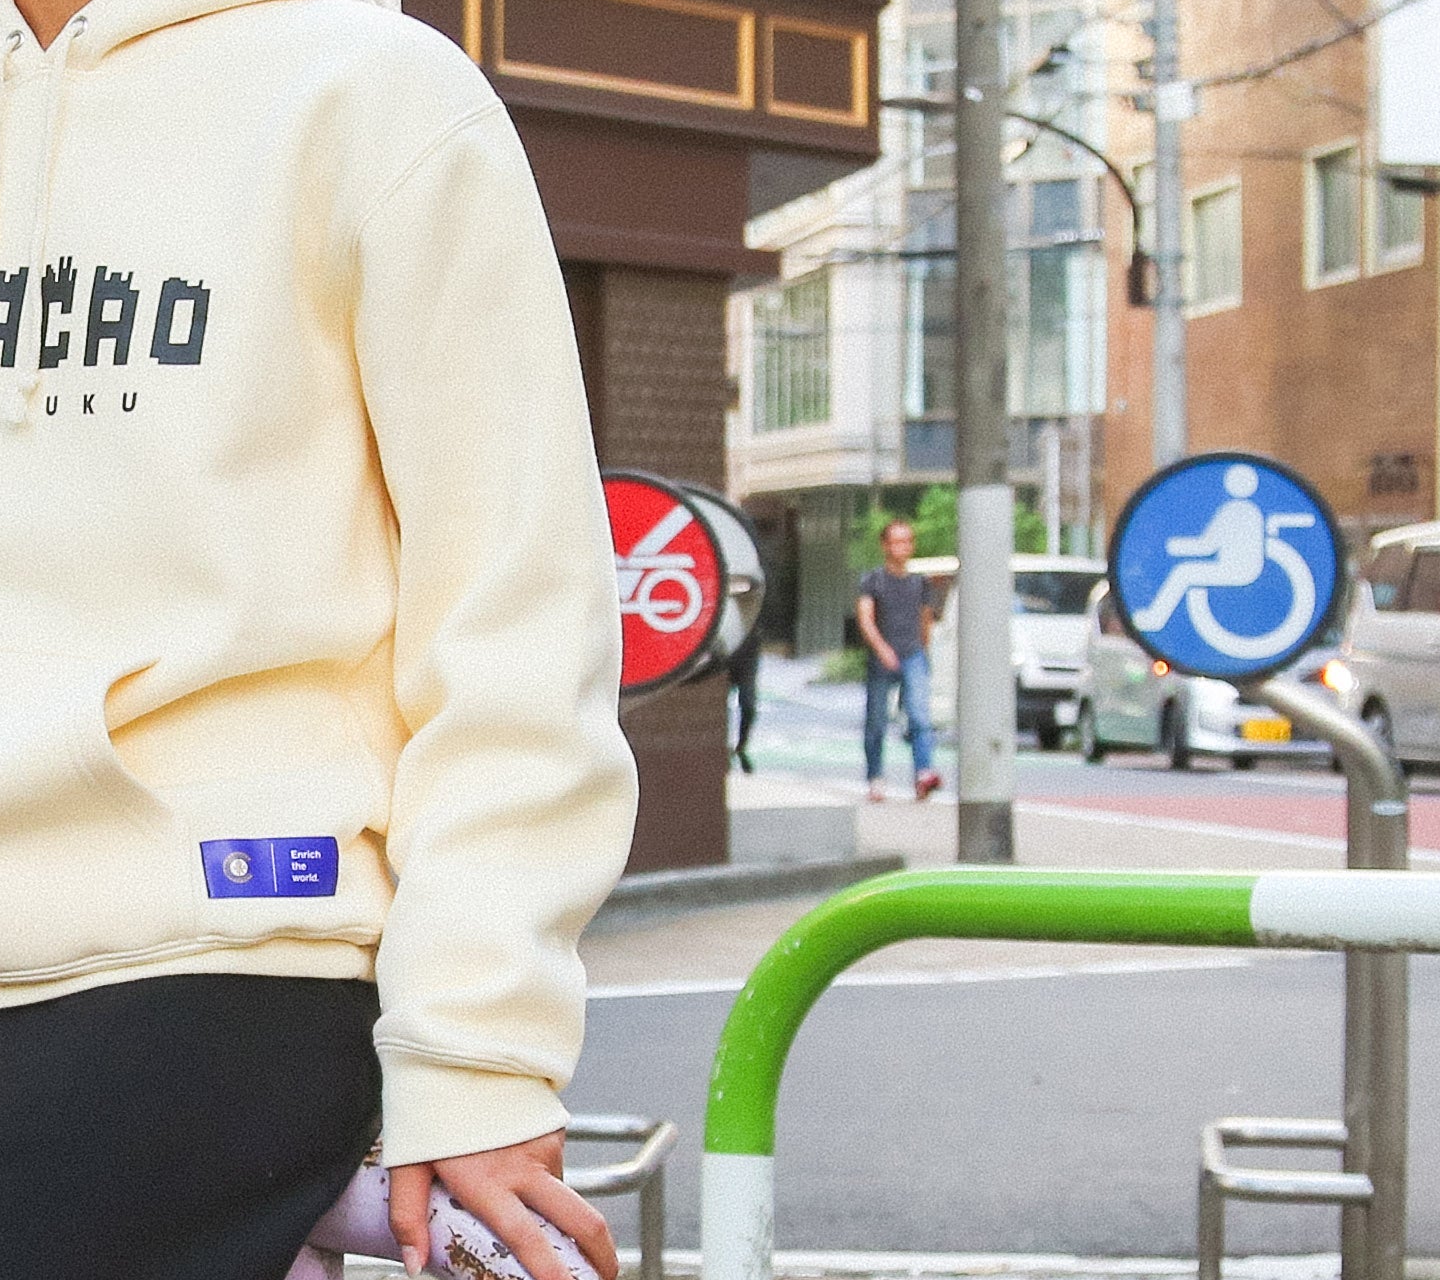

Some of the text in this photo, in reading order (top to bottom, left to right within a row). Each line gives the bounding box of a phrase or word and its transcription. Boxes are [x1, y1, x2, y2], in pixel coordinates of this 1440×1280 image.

[290, 850, 321, 859] Enrich
[291, 862, 307, 871] the
[292, 873, 319, 883] world.
